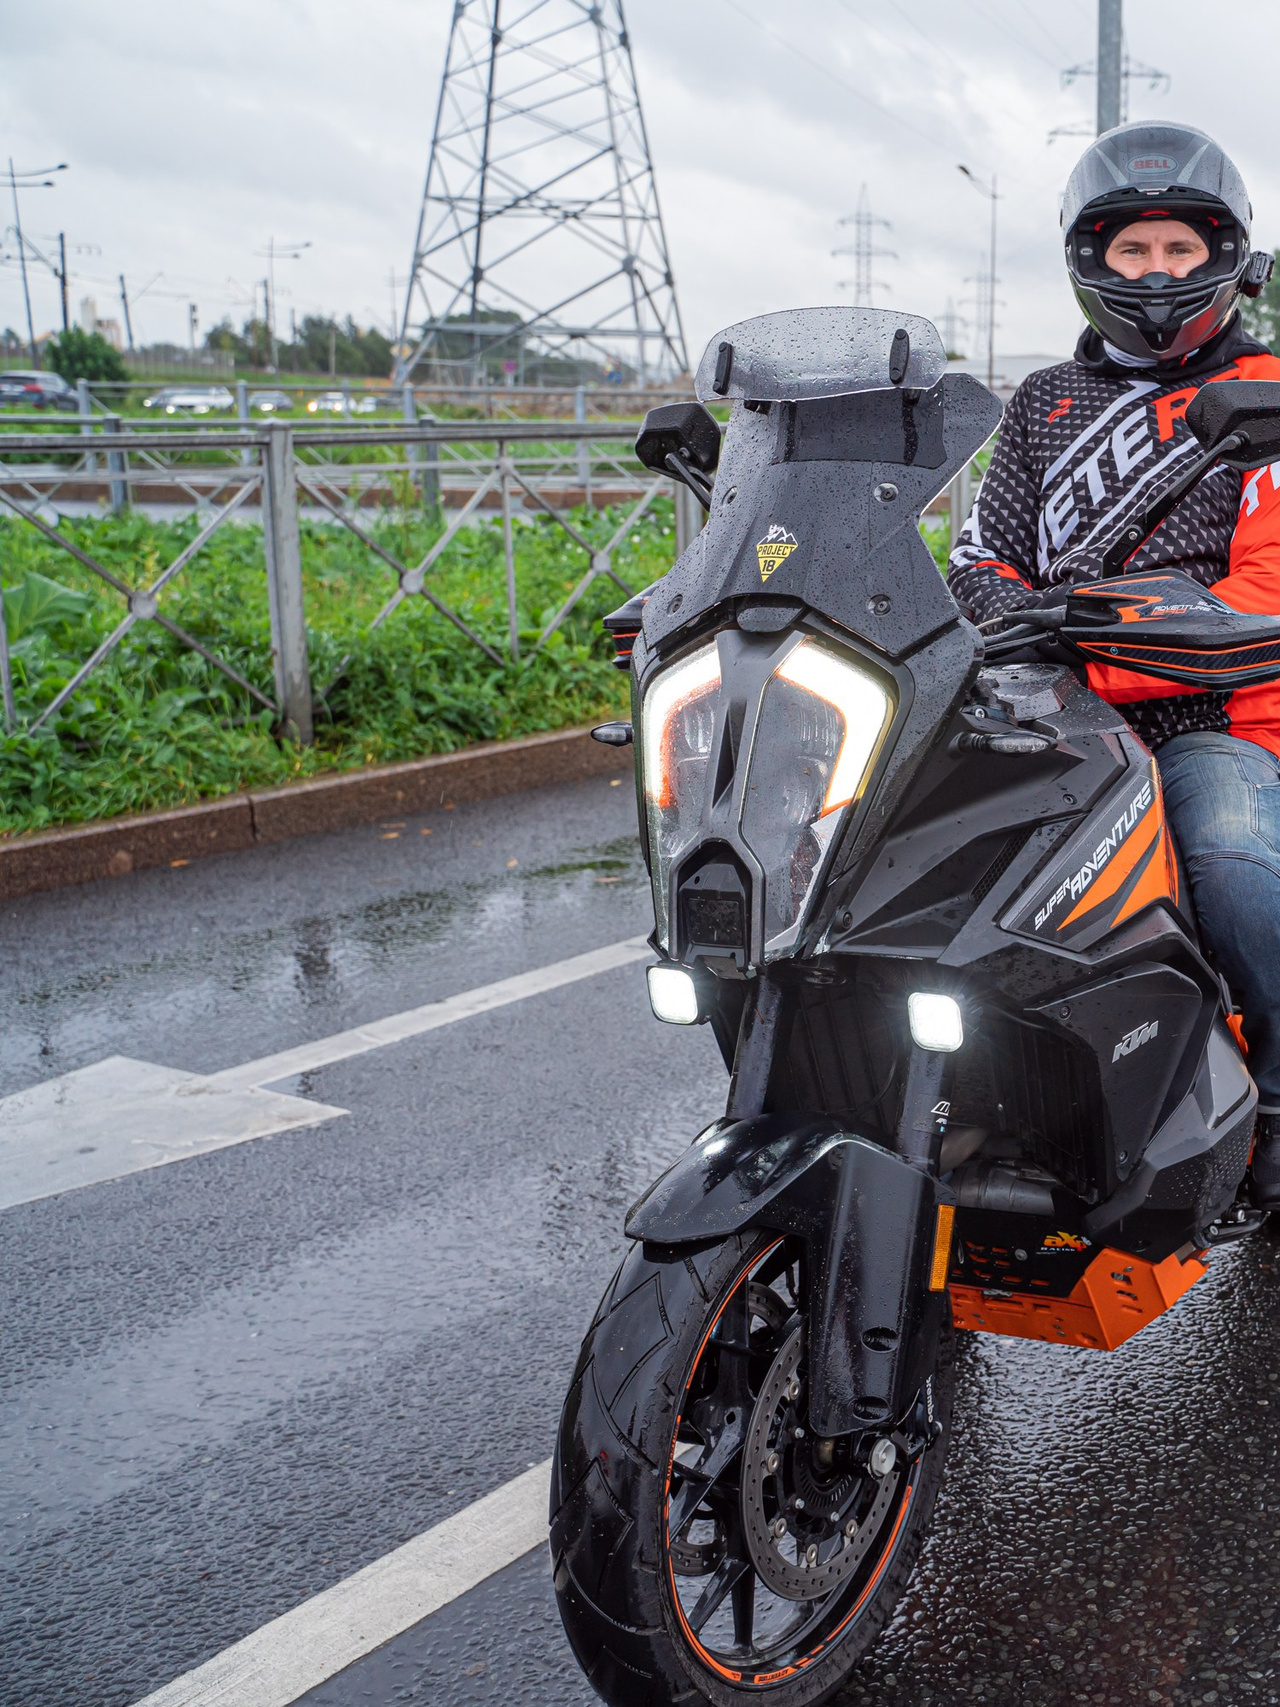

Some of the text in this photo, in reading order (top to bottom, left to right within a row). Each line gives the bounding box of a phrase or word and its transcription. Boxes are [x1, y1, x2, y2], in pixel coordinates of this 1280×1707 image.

[1133, 159, 1170, 170] BELL
[758, 545, 795, 556] PROJECT
[762, 559, 776, 572] 18
[1034, 780, 1152, 931] SUPER ADVENTURE
[1111, 1020, 1159, 1064] KTM
